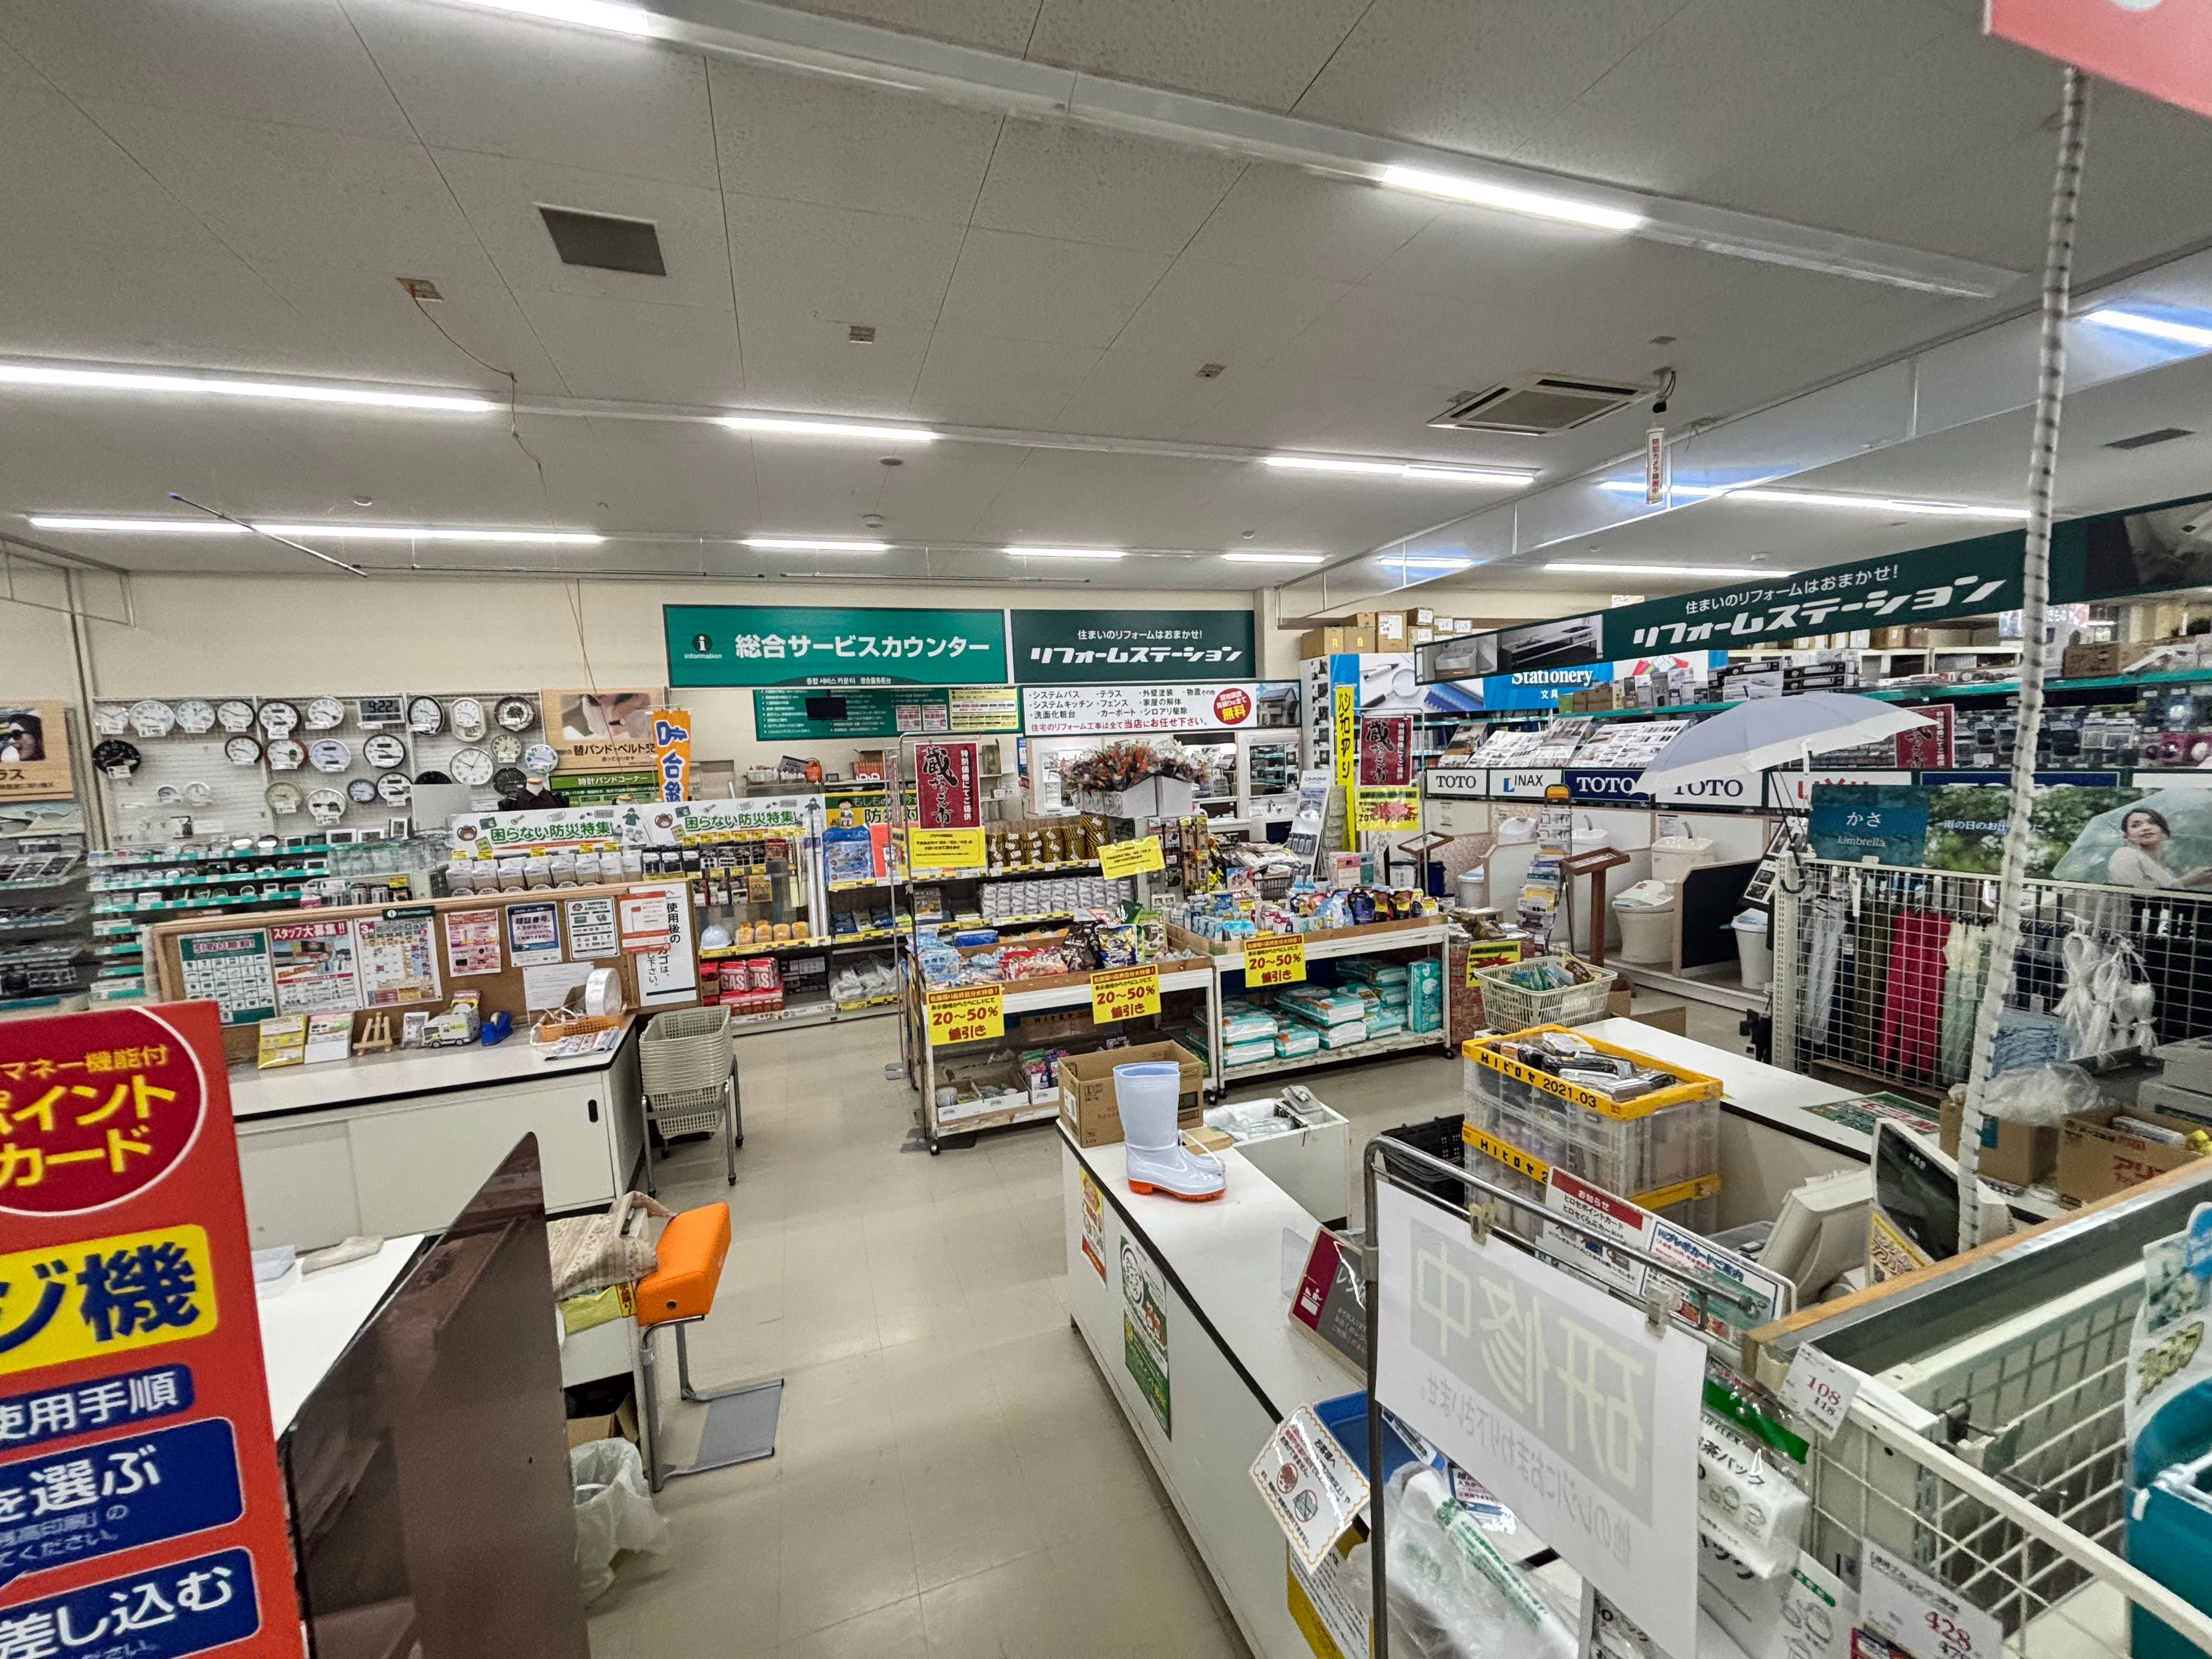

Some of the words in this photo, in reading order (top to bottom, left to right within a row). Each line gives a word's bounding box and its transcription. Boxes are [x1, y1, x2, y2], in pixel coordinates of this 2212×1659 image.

[1685, 565, 1899, 615] 住まいのリフォームはおまかせ!
[1633, 575, 2006, 647] リフォームステーション
[1078, 630, 1202, 640] 住まいのリフォームはおまかせ!
[735, 634, 990, 658] 総合サービスカウンター
[1030, 646, 1243, 664] リフォームステーション
[1511, 670, 1594, 687] Stationery
[1222, 705, 1246, 721] 無料
[578, 776, 648, 786] 時計バンドコーナー
[960, 749, 972, 821] 特別価格にてご提供
[1436, 775, 1477, 789] TOTO
[1576, 776, 1636, 795] TOTO
[1673, 778, 1743, 798] TOTO
[685, 810, 796, 830] 困らない防災特集
[1847, 812, 1882, 827] かさ
[490, 821, 613, 843] 困らない防災特集
[667, 902, 681, 944] 使用後の
[1262, 969, 1291, 984] 値引き
[1111, 1003, 1145, 1019] 値引き
[949, 1025, 986, 1041] 値引き
[1543, 1079, 1597, 1108] 2021.03
[1578, 1189, 1610, 1211] お知らせ
[1564, 1194, 1624, 1230] ヒロセポイントカード
[1808, 1376, 1841, 1406] 108
[1314, 1438, 1336, 1469] お客様へ
